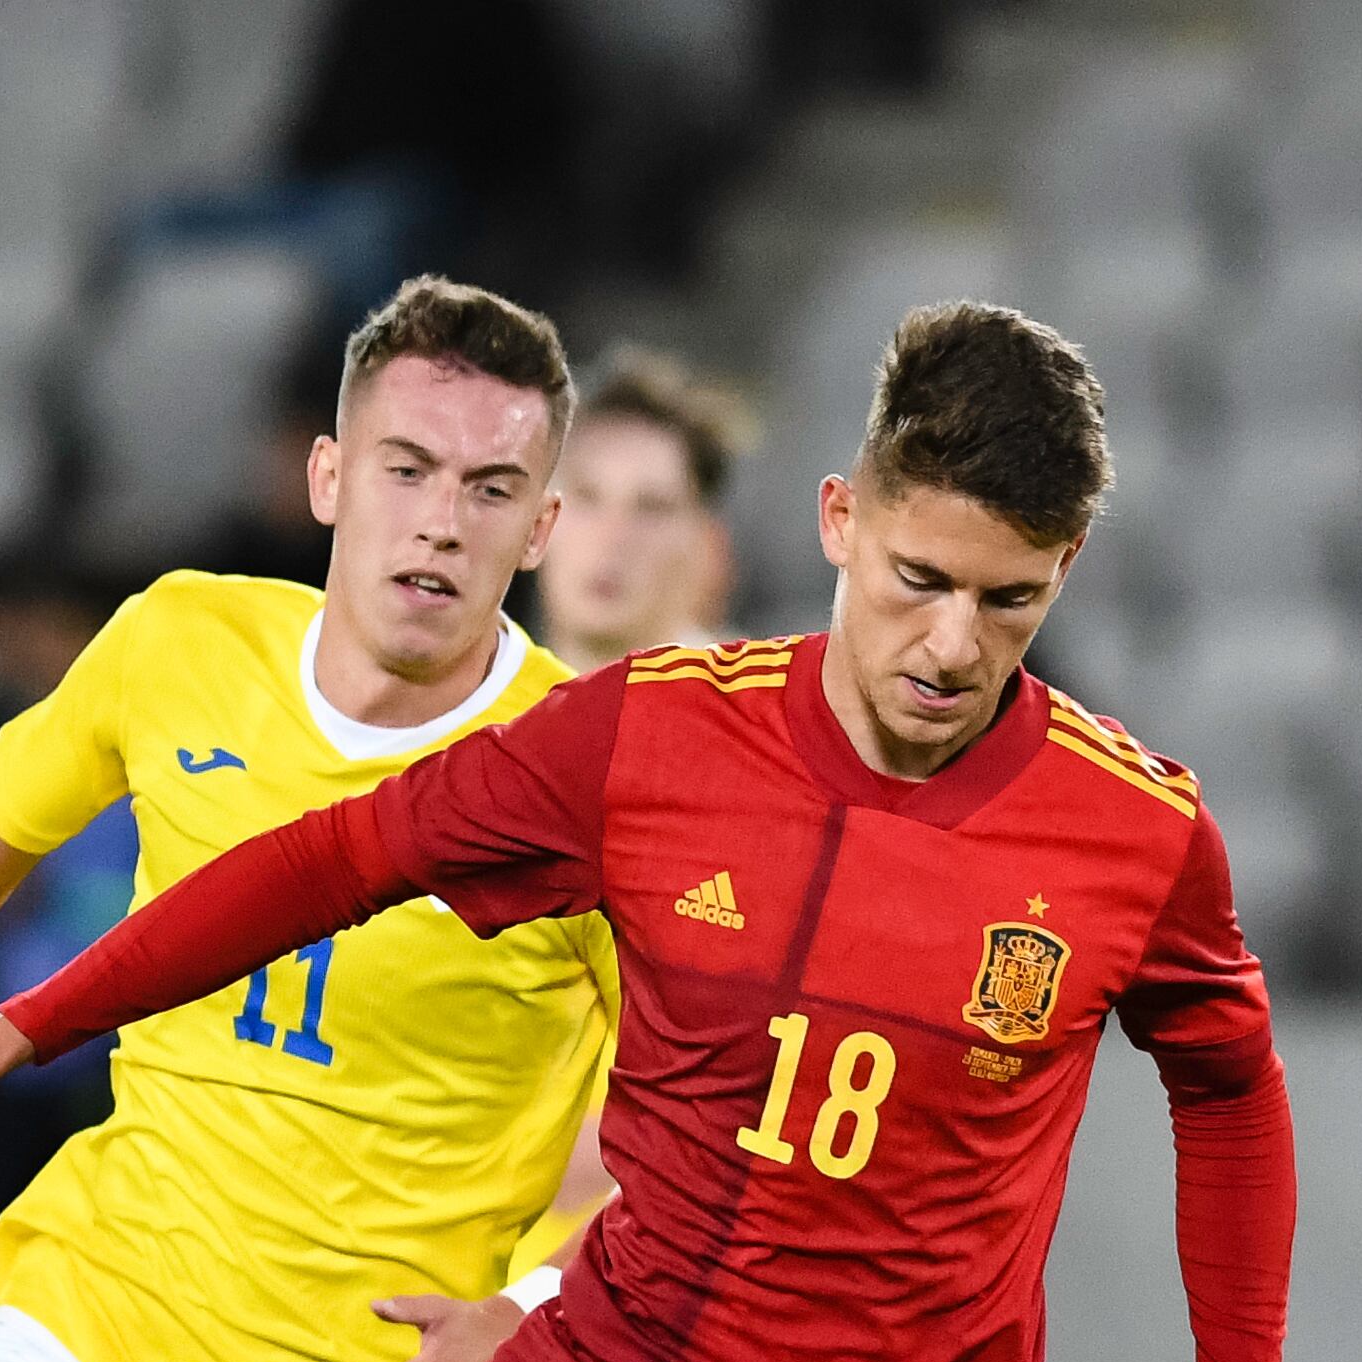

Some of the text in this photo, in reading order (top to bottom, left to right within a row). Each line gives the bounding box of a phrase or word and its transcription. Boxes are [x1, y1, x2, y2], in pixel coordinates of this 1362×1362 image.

[674, 898, 745, 930] adidas
[233, 937, 334, 1067] 11
[736, 1012, 896, 1179] 18
